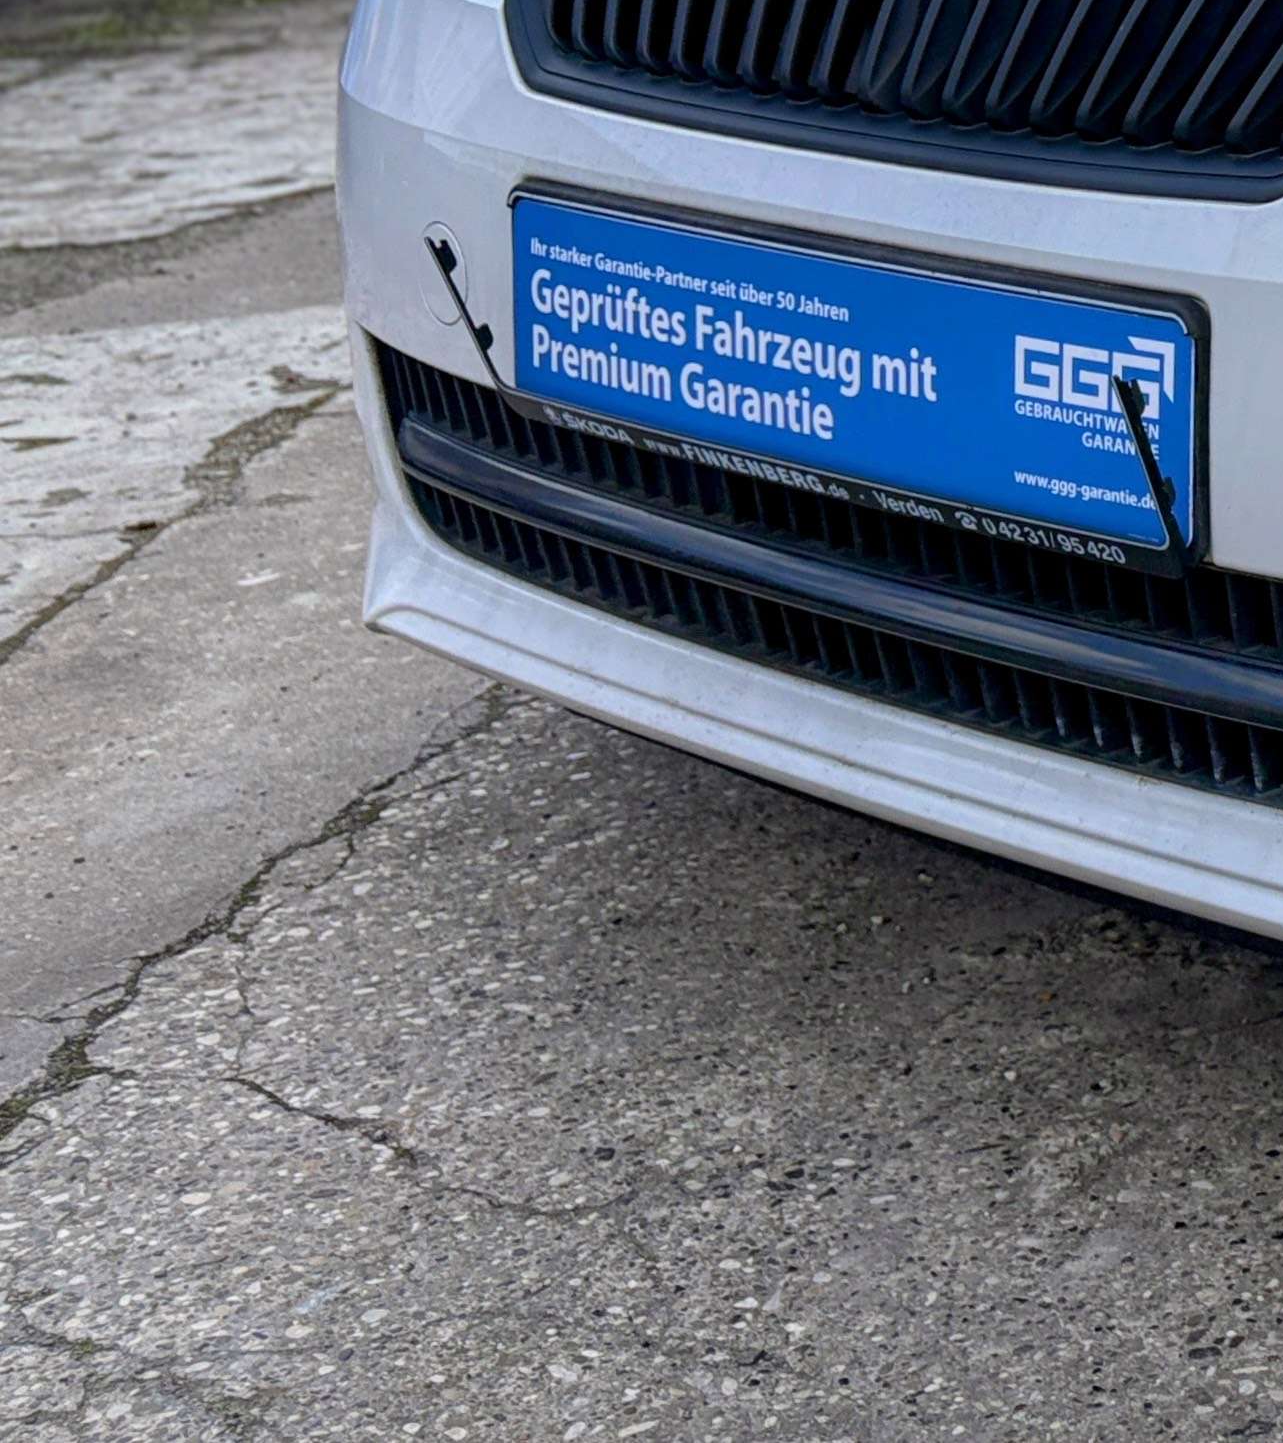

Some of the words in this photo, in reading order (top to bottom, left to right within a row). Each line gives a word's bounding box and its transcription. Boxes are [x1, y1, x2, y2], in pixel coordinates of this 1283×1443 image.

[530, 237, 548, 258] Ihr
[550, 244, 593, 268] starker
[594, 252, 708, 294] Garantie-Partner
[710, 278, 737, 300] seit
[739, 282, 775, 307] über
[776, 290, 796, 311] 50
[797, 295, 849, 323] Jahren
[531, 268, 688, 346] Geprüftes
[695, 304, 862, 397] Fahrzeug
[872, 347, 938, 402] mit
[532, 323, 672, 402] Premium
[680, 362, 834, 440] Garantie
[1014, 399, 1160, 441] GEBRAUCHTWAN
[1082, 431, 1160, 461] GARANE
[872, 489, 945, 524] Verden
